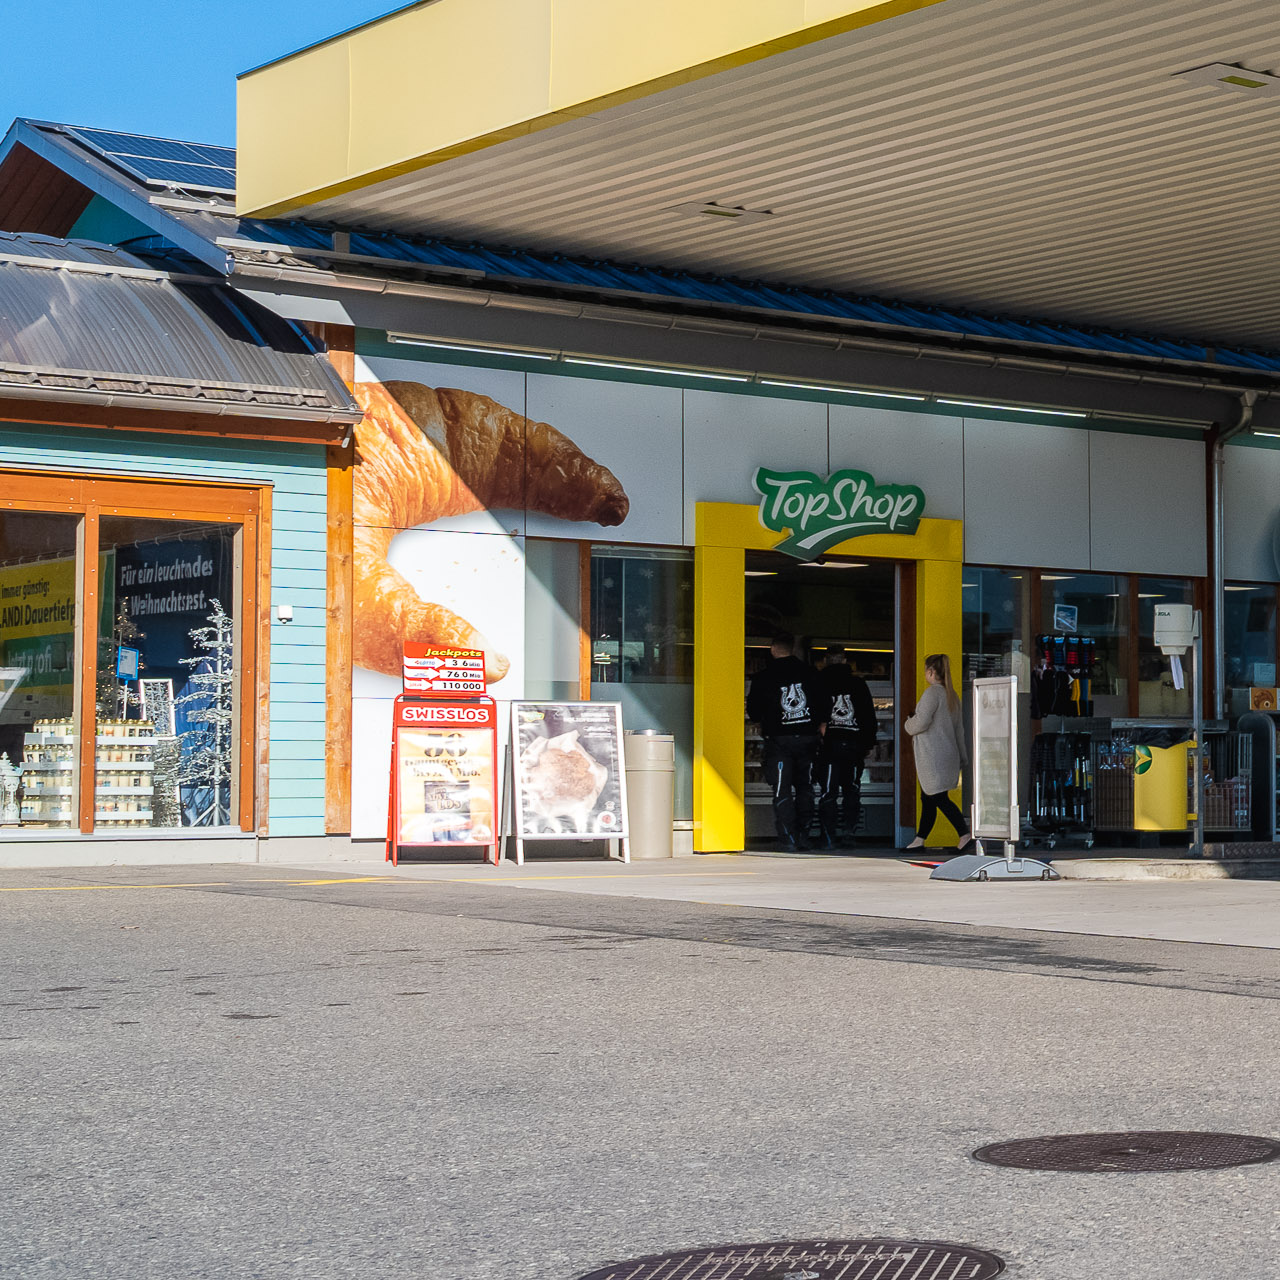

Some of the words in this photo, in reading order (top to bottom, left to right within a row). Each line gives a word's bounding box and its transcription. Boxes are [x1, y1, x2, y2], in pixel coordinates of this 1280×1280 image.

[121, 564, 137, 587] Für
[138, 562, 154, 585] ein
[0, 605, 24, 628] ANDI
[424, 648, 482, 658] Jackpots
[405, 709, 487, 721] SWISSLOS
